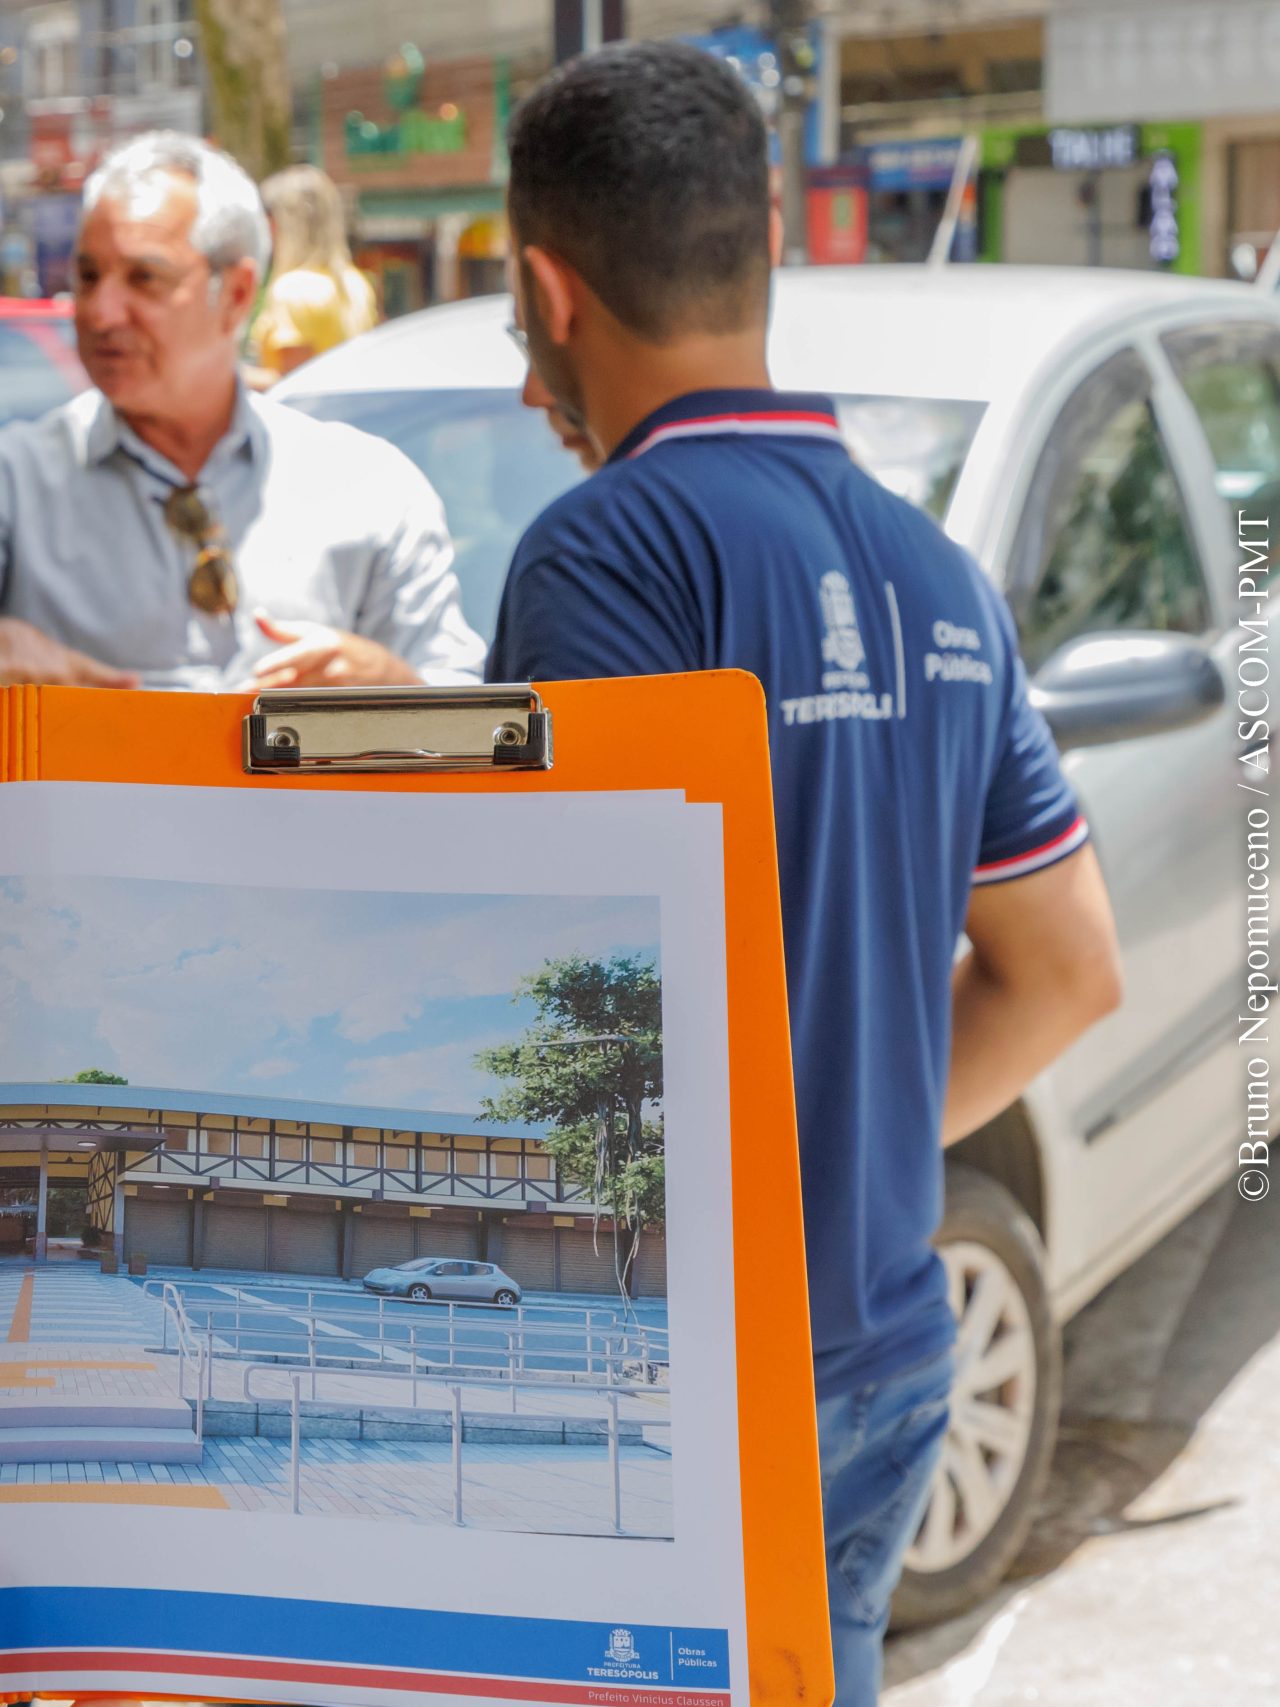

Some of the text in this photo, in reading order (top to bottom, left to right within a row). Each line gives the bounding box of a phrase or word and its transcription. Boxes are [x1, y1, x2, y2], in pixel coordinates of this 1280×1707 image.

[678, 1647, 706, 1656] Obras
[678, 1657, 718, 1668] Públicas
[587, 1667, 659, 1680] TERESÓPOLIS
[588, 1691, 630, 1703] Prefeito
[677, 1696, 724, 1707] Claussen
